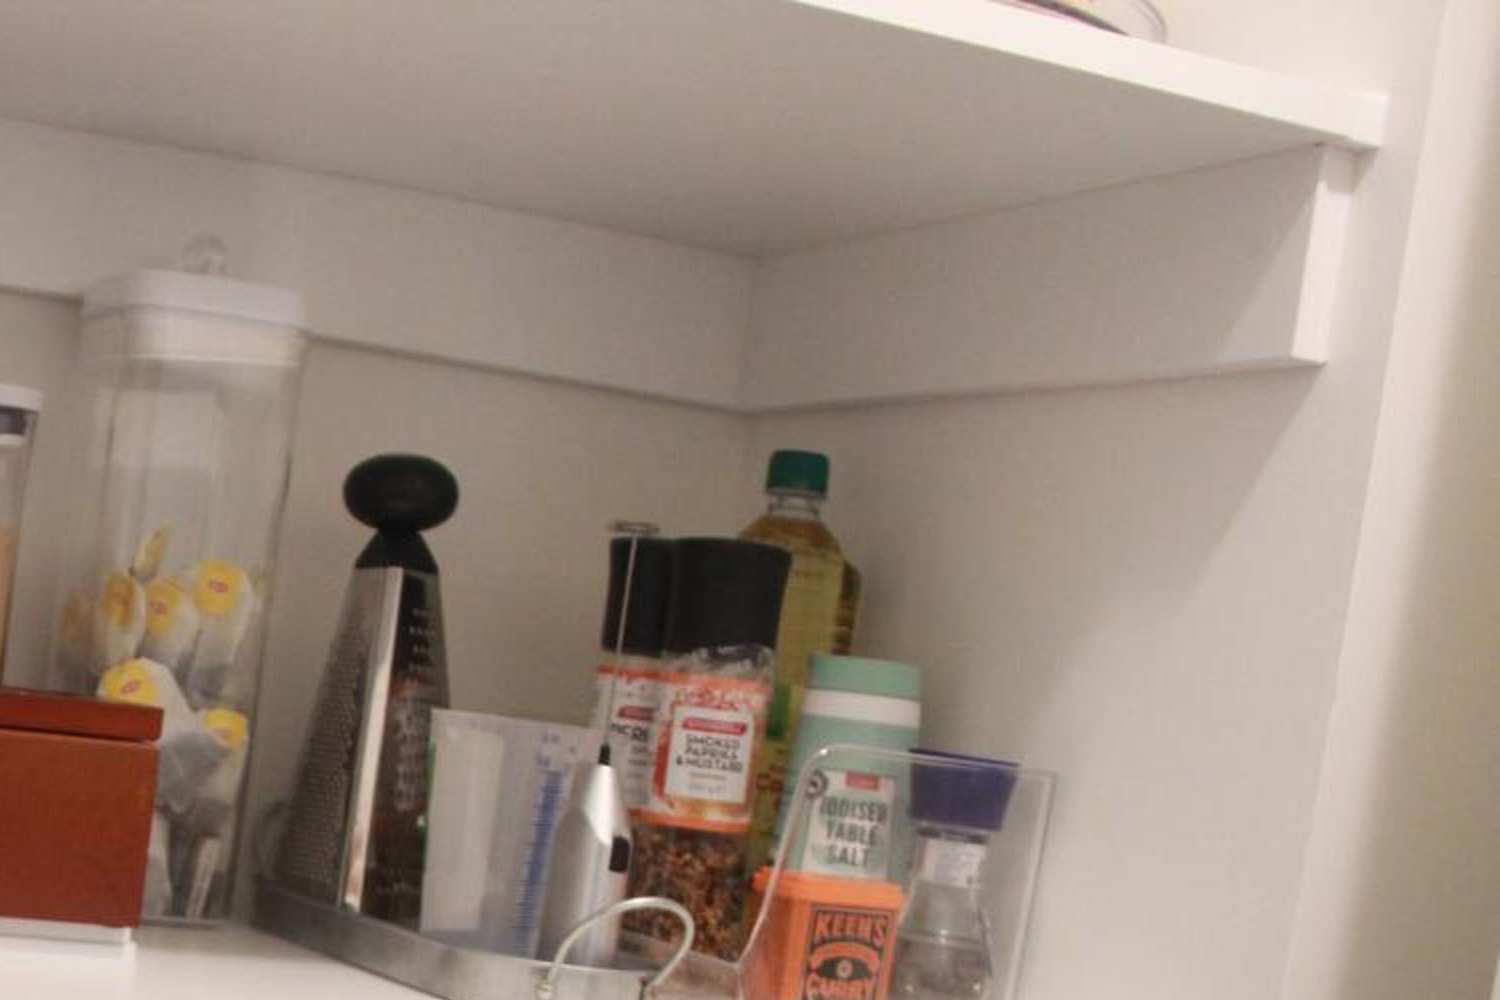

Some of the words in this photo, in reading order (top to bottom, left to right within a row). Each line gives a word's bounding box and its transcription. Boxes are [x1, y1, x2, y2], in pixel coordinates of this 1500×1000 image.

[819, 797, 888, 823] IODISED
[826, 819, 880, 846] TABLE
[825, 844, 868, 866] SALT
